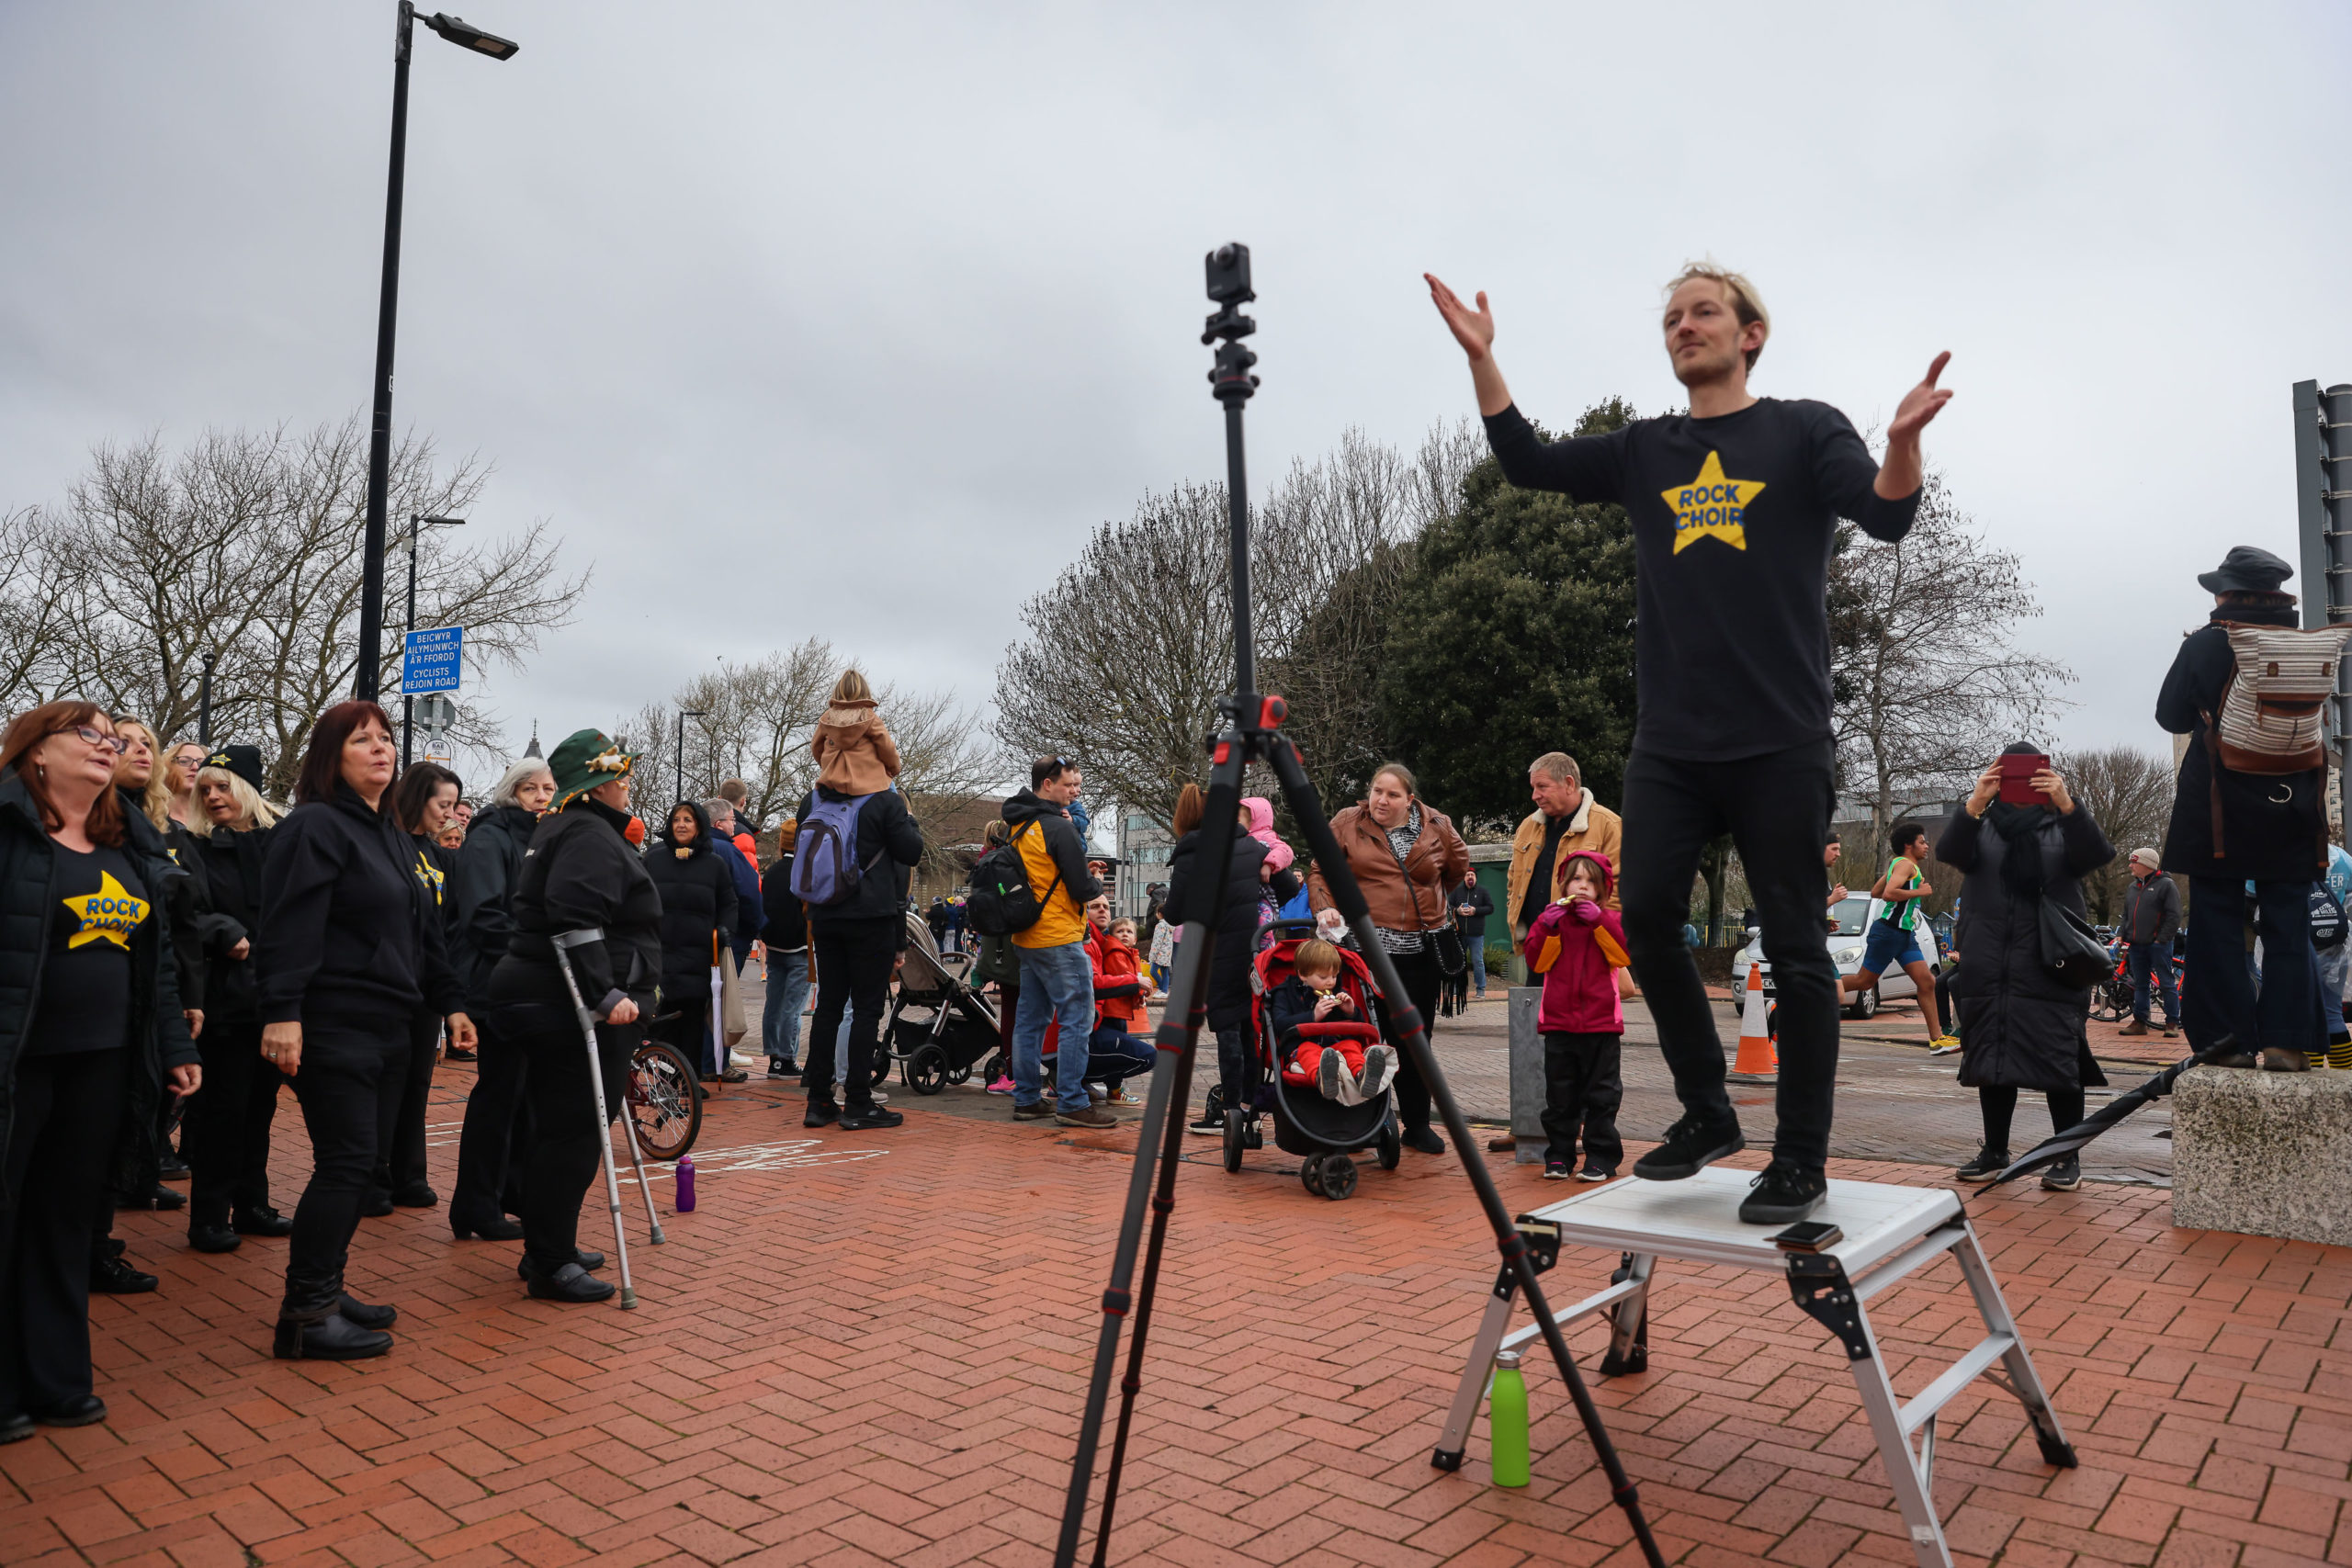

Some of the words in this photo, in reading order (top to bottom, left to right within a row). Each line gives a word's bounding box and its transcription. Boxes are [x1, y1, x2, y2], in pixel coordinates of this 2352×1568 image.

[1679, 484, 1740, 508] ROCK
[1675, 507, 1745, 530] CHOIR
[417, 632, 451, 643] BEICWYR
[407, 641, 458, 654] AILYMUNWCH
[424, 652, 455, 663] FFORDD
[413, 667, 449, 678] CYCLISTS
[405, 679, 433, 690] REJOIN
[435, 677, 457, 687] ROAD
[86, 897, 141, 919] ROCK
[79, 918, 138, 935] CHOIR
